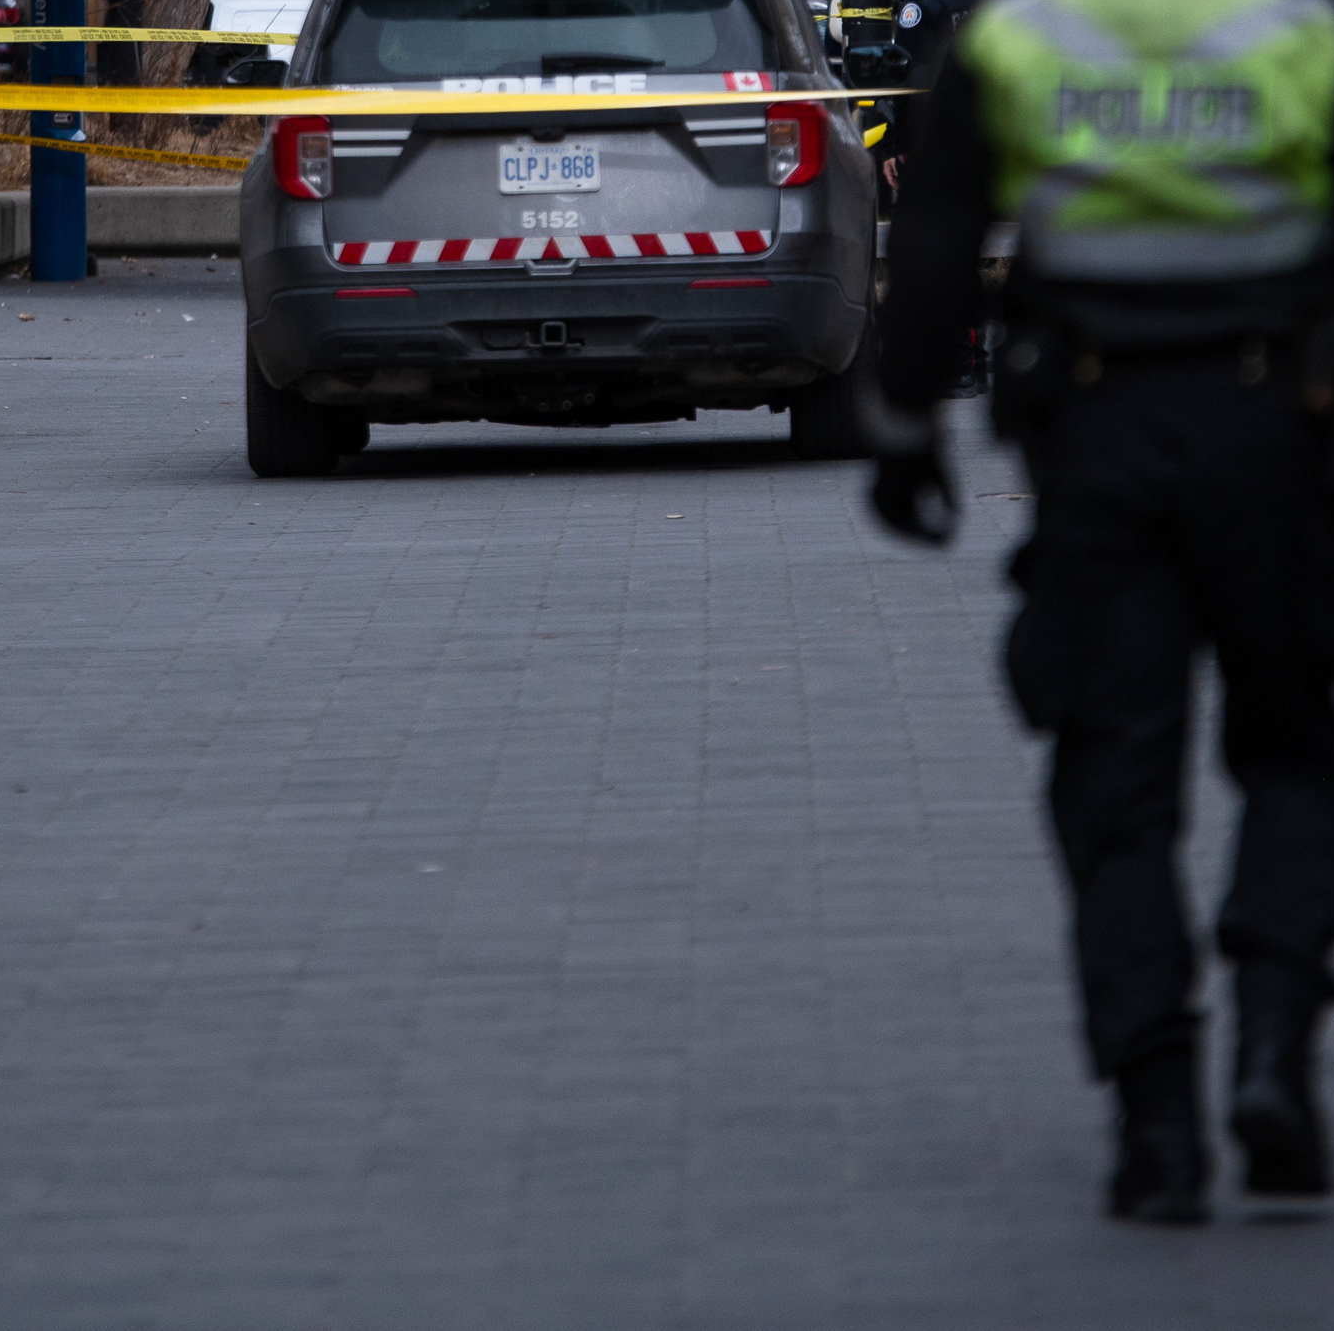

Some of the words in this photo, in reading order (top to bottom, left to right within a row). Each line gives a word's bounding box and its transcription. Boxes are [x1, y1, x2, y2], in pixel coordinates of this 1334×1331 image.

[442, 74, 648, 95] POLICE
[504, 157, 550, 181] CLPJ
[561, 155, 595, 179] 868
[522, 211, 579, 229] 5152
